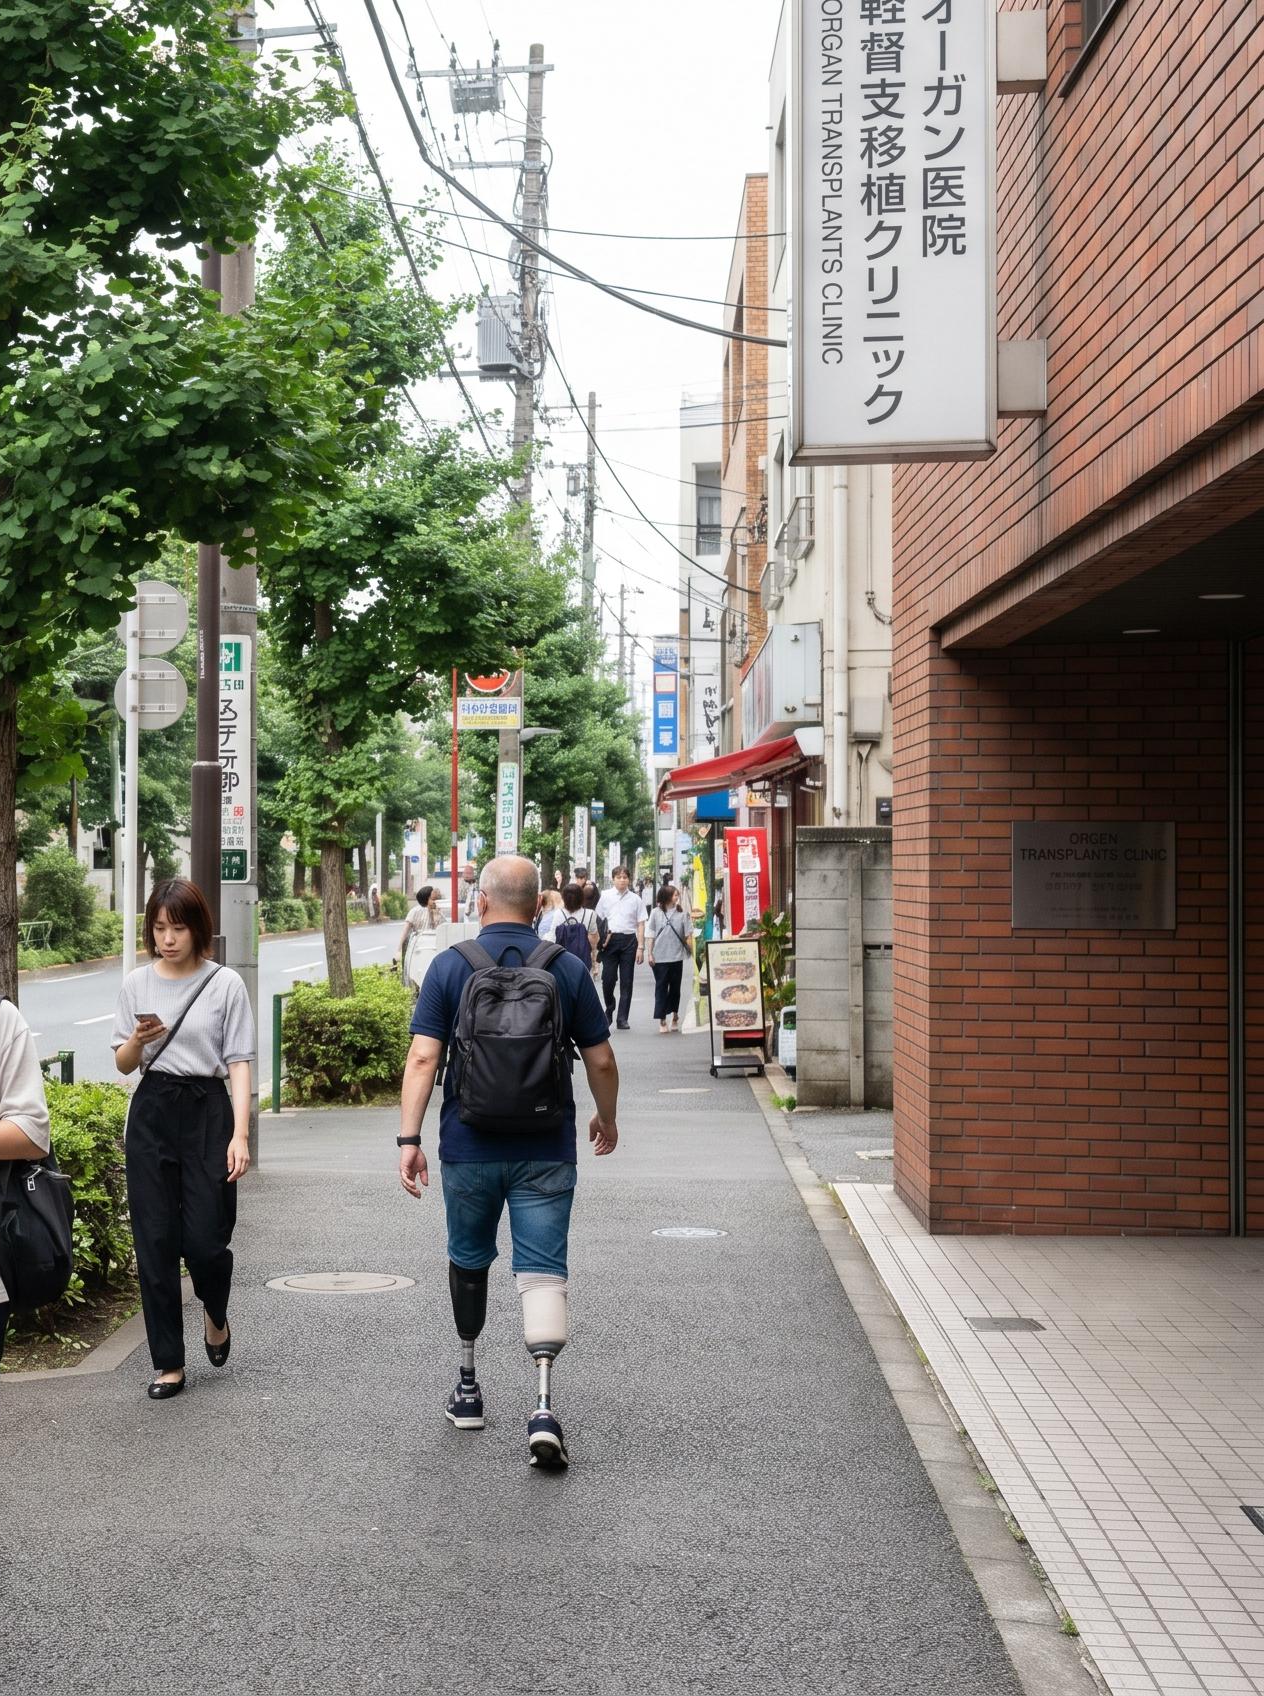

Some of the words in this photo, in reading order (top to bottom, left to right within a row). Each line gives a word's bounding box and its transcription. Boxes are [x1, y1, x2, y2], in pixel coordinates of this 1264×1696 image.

[821, 0, 843, 85] ORGAN
[821, 93, 843, 274] TRANSPLANTS
[821, 283, 843, 365] CLINIC
[1020, 848, 1118, 861] TRANSPLANTS
[1123, 848, 1167, 861] CLINIC
[1069, 832, 1118, 845] ORGEN
